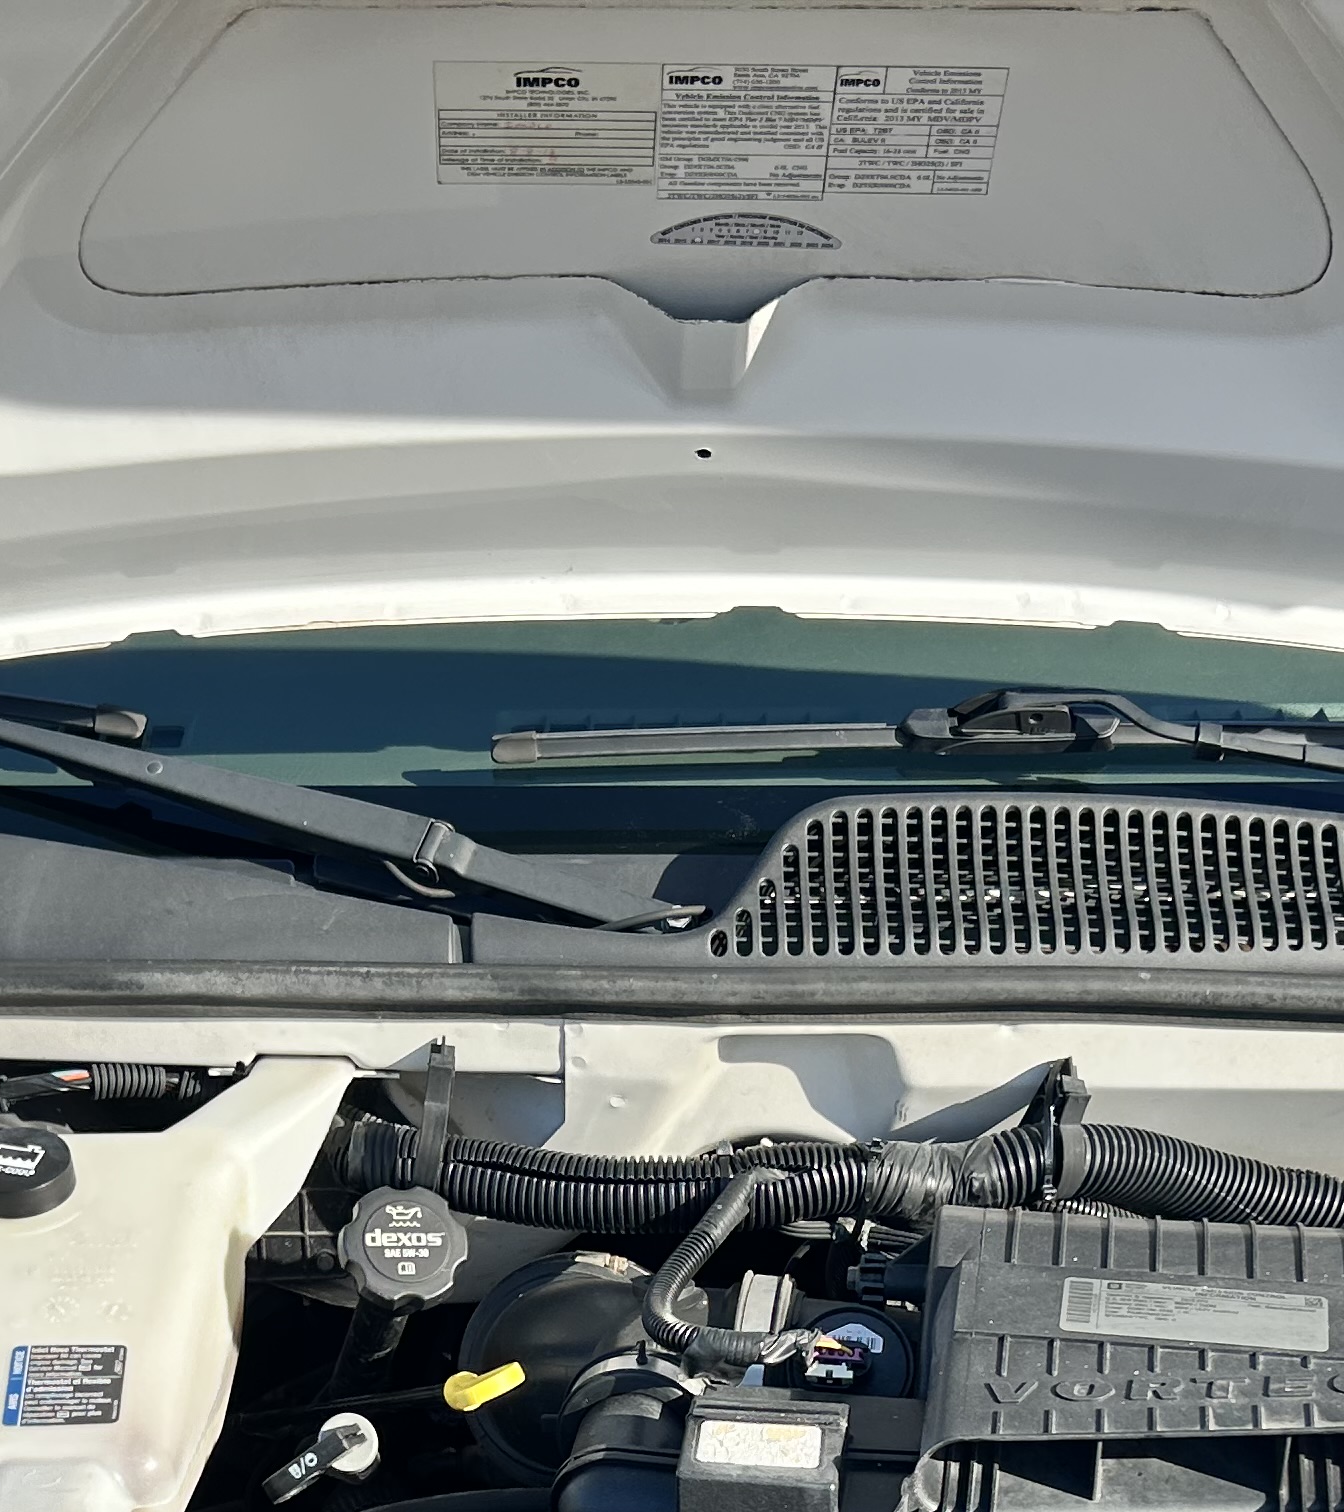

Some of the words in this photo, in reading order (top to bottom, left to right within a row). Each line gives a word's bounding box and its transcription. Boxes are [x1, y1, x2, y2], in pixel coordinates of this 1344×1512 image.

[516, 77, 579, 88] IMPCO
[669, 76, 723, 85] IMPCO
[840, 79, 880, 87] IMPCO
[365, 1228, 443, 1247] dexos
[384, 1249, 402, 1258] SAE
[403, 1249, 429, 1258] 5W-30
